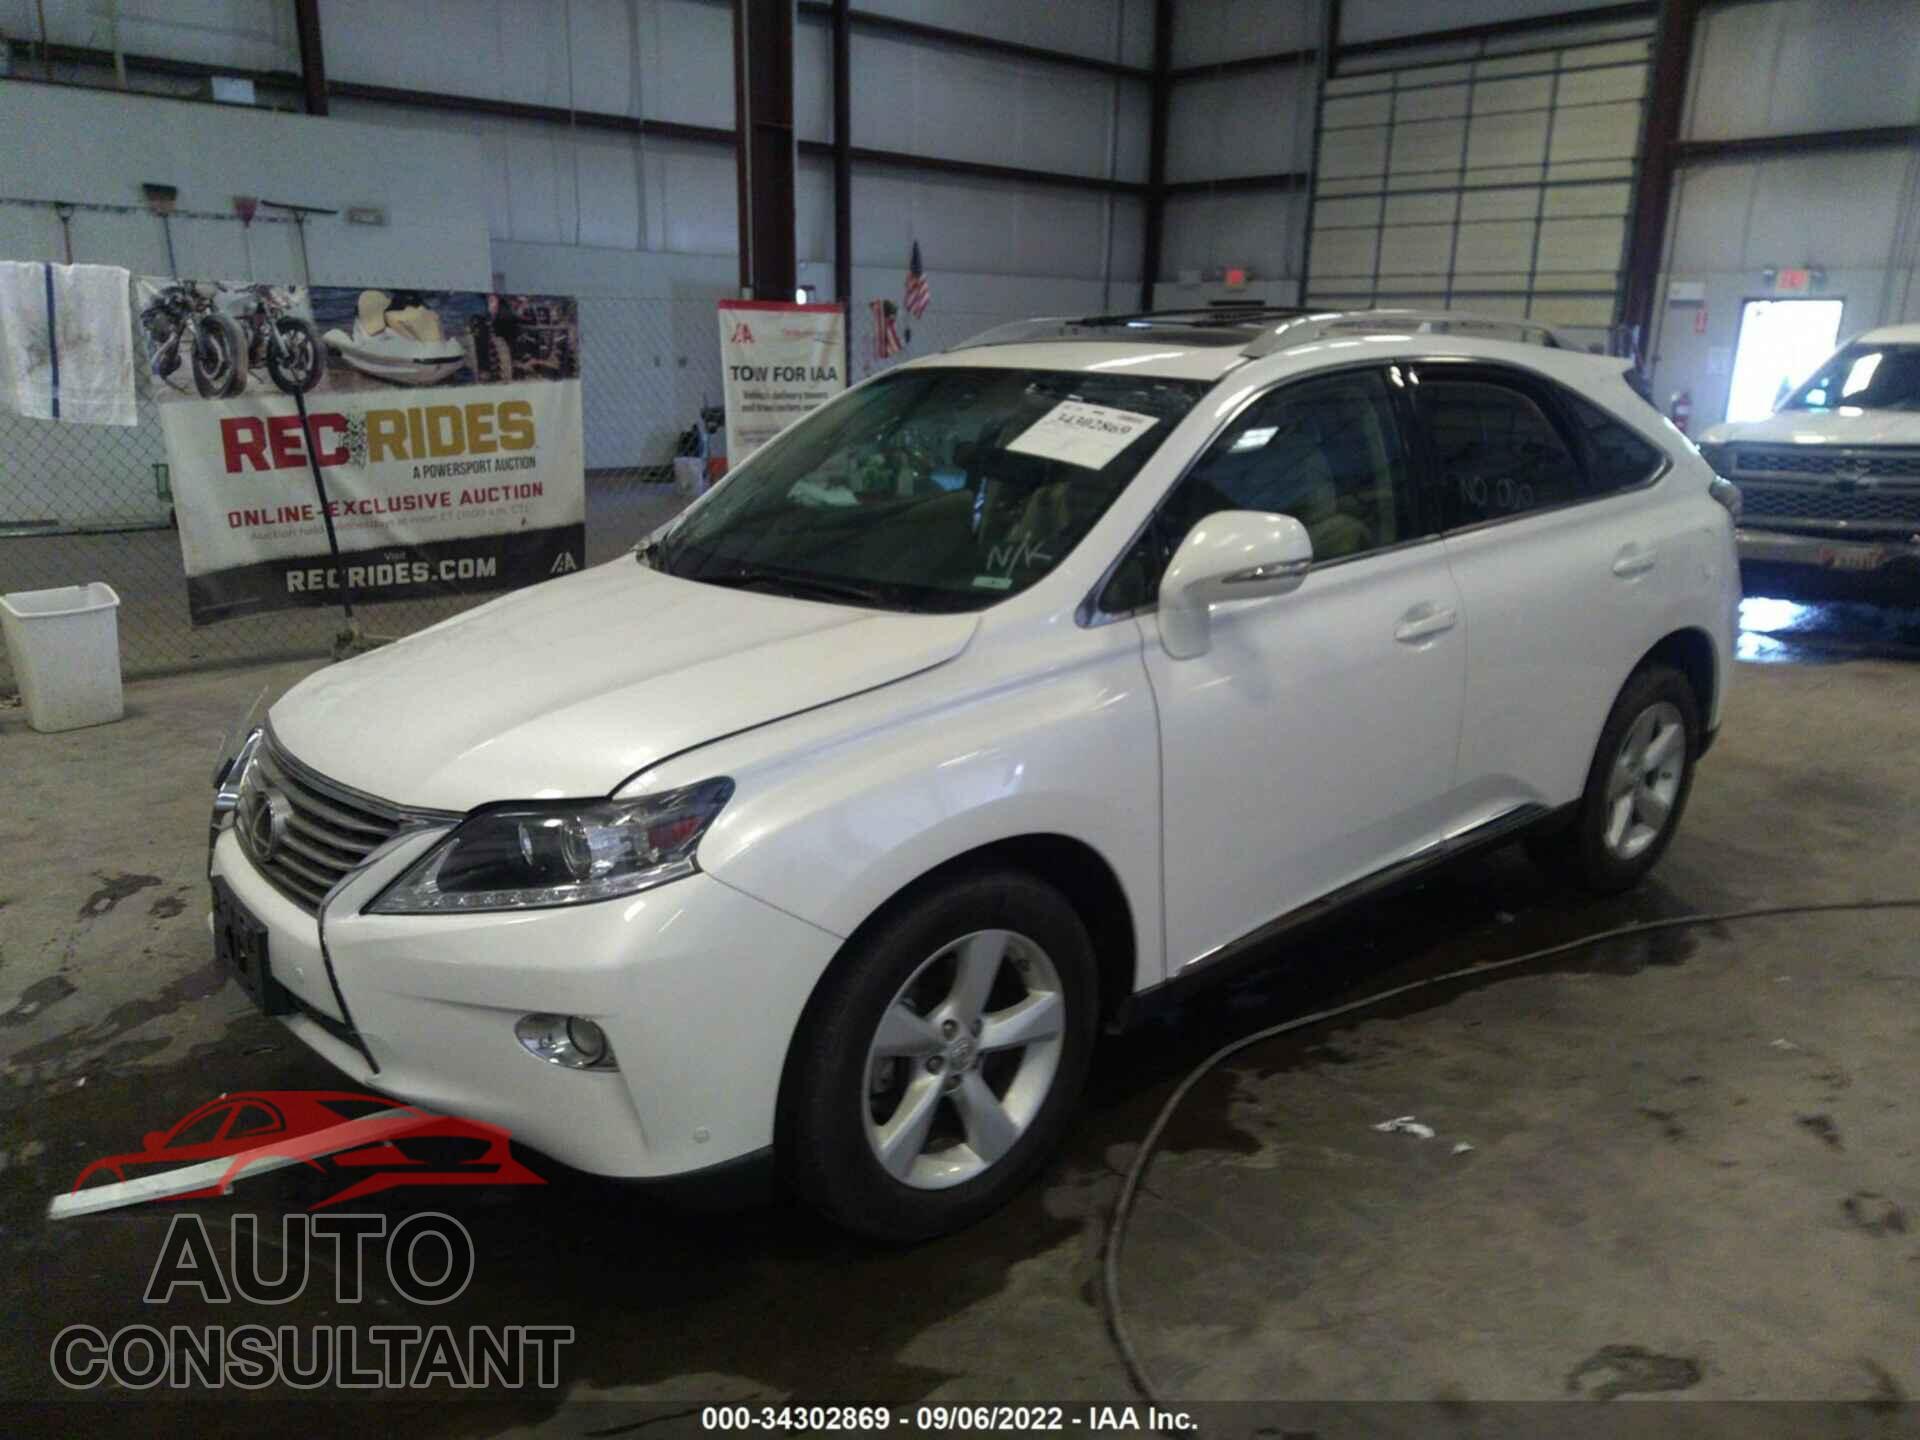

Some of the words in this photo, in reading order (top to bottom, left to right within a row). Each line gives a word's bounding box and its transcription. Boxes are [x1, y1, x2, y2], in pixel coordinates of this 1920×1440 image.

[730, 365, 769, 381] TOW
[773, 366, 806, 381] FOR
[810, 366, 838, 381] IAA
[220, 412, 351, 474] REC
[366, 400, 535, 463] RIDES
[413, 465, 421, 479] A
[423, 459, 492, 479] POWERSPORT
[494, 456, 537, 473] AUCTION
[459, 481, 544, 506] AUCTION
